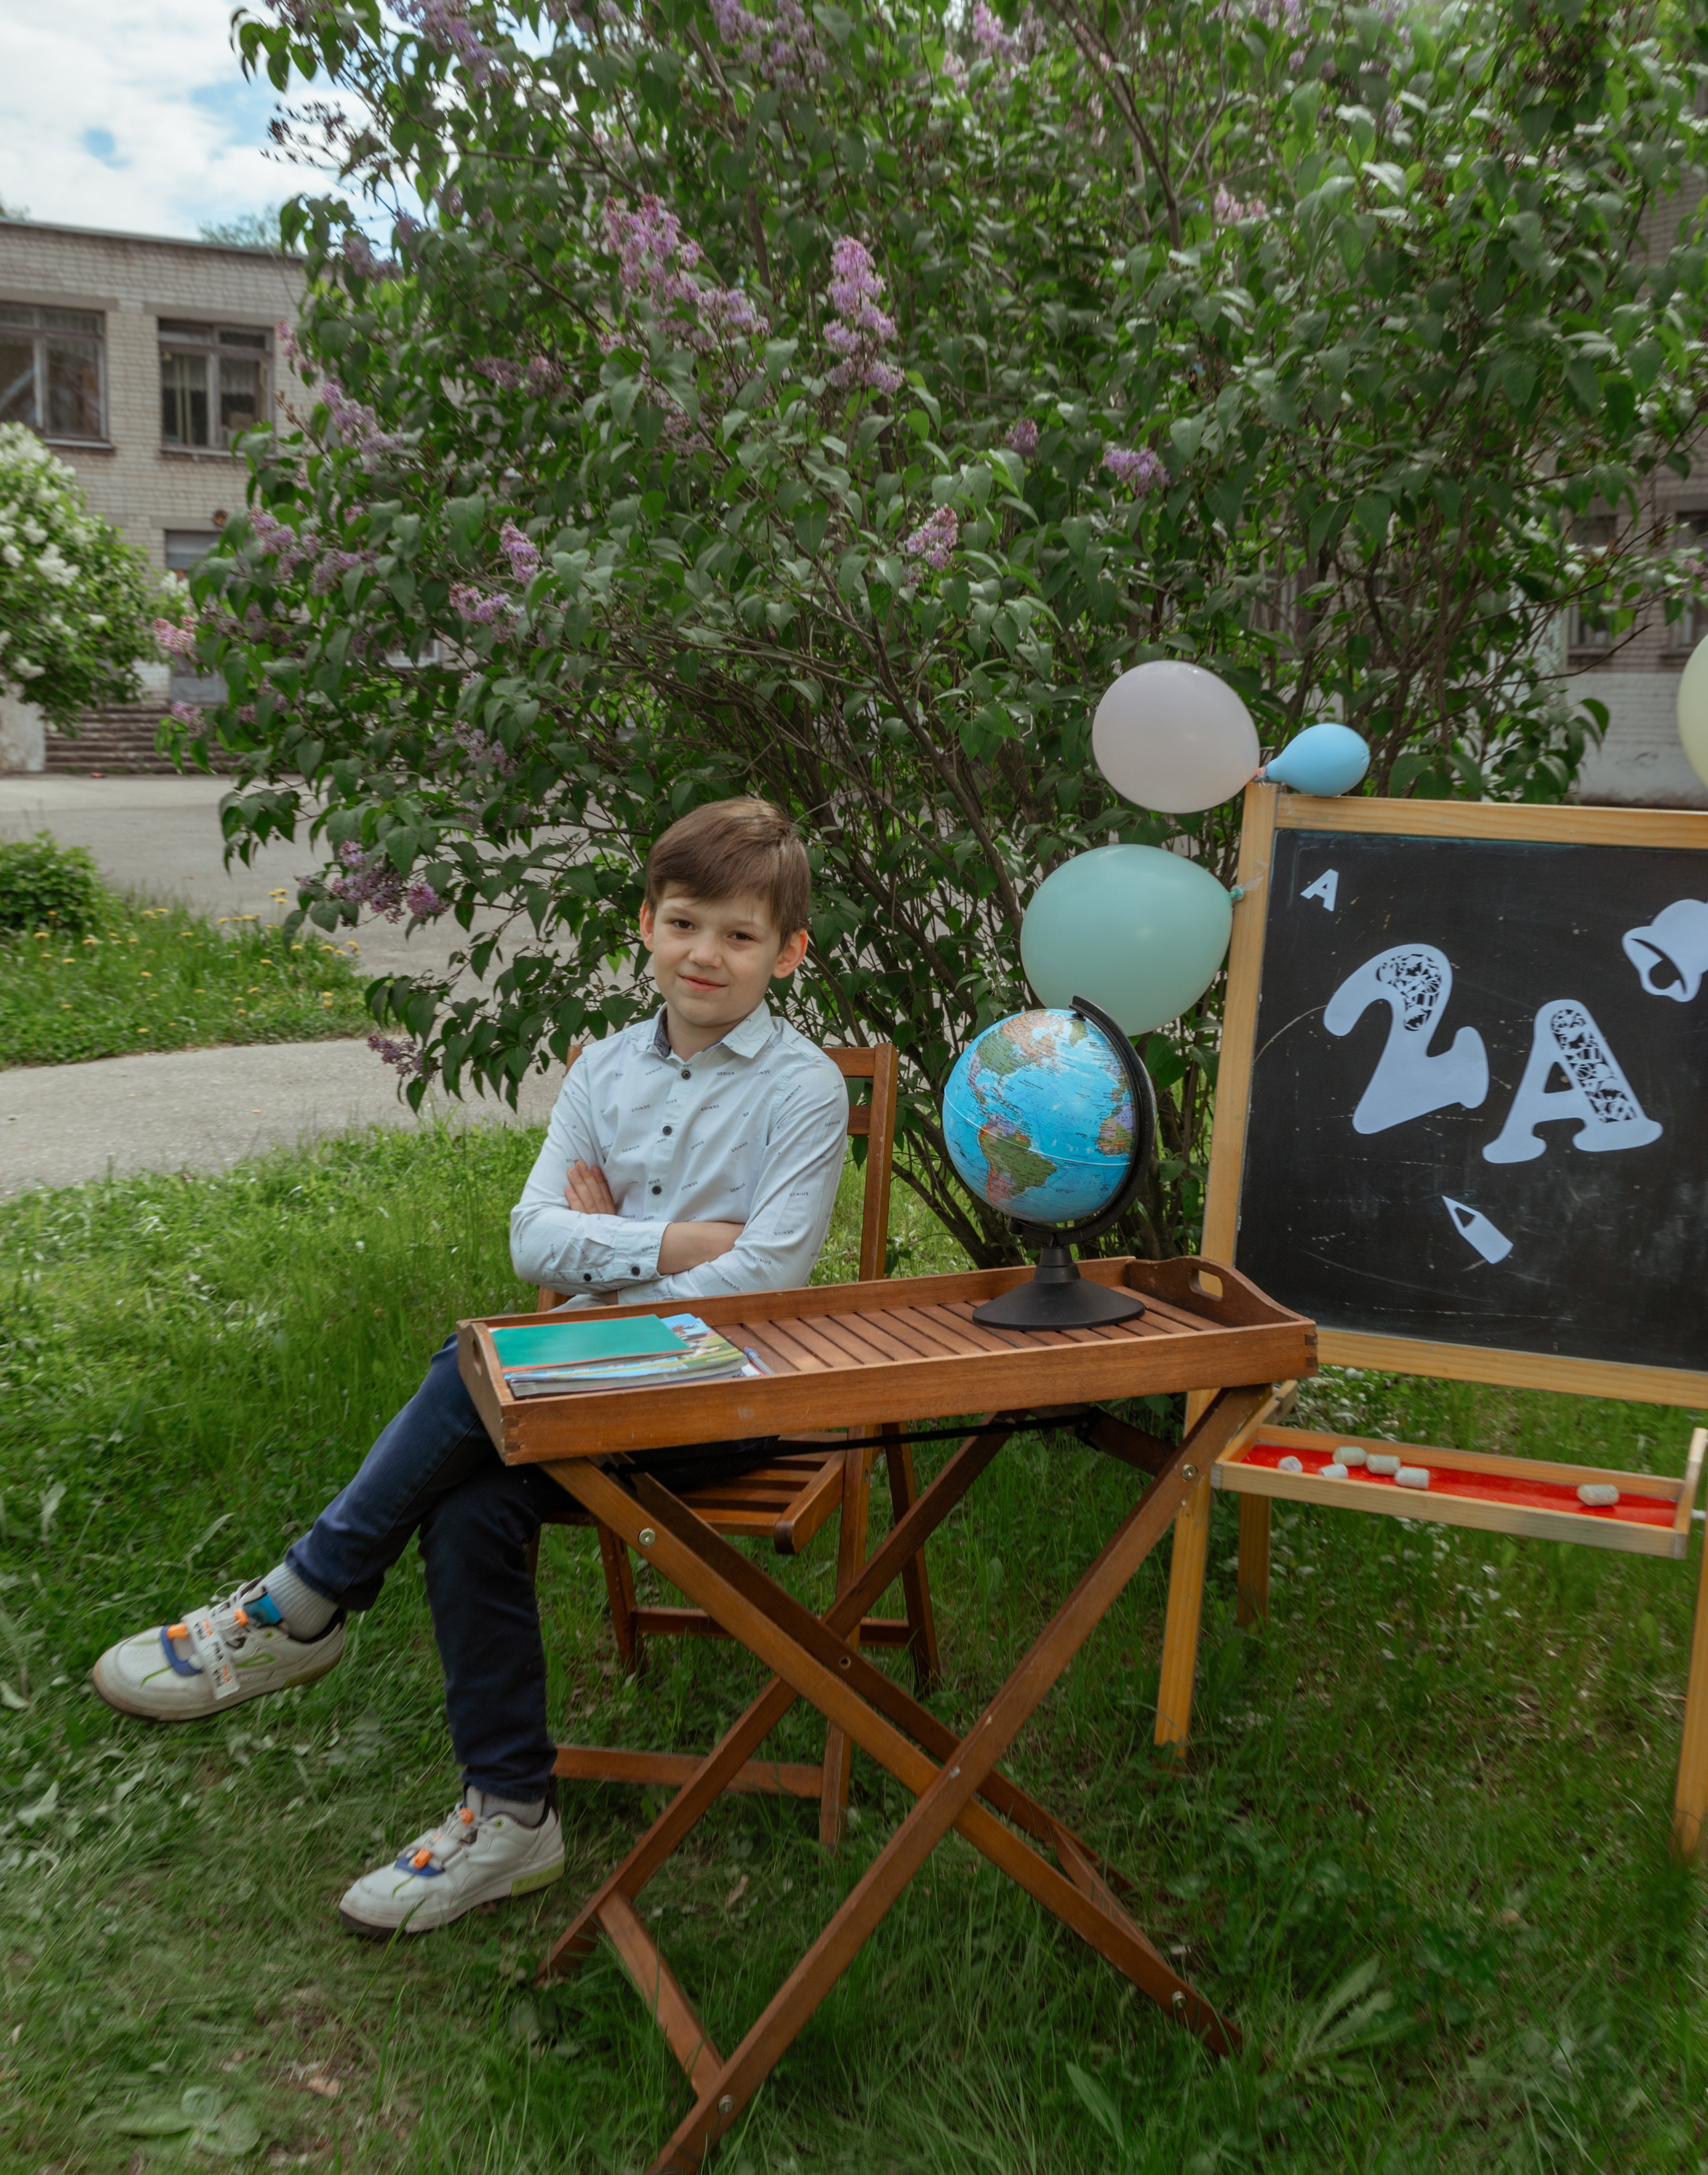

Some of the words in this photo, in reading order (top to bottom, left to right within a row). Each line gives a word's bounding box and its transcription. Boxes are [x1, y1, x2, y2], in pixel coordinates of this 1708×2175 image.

[645, 1066, 663, 1075] GENIUS
[785, 1084, 802, 1102] GENIUS
[631, 1104, 651, 1113] GENIUS
[621, 1144, 640, 1153] GENIUS
[691, 1140, 705, 1150] GENIUS
[731, 1141, 748, 1153] GENIUS
[681, 1181, 698, 1191] GENIUS
[729, 1182, 745, 1193] GENIUS
[721, 1277, 740, 1291] GENIUS
